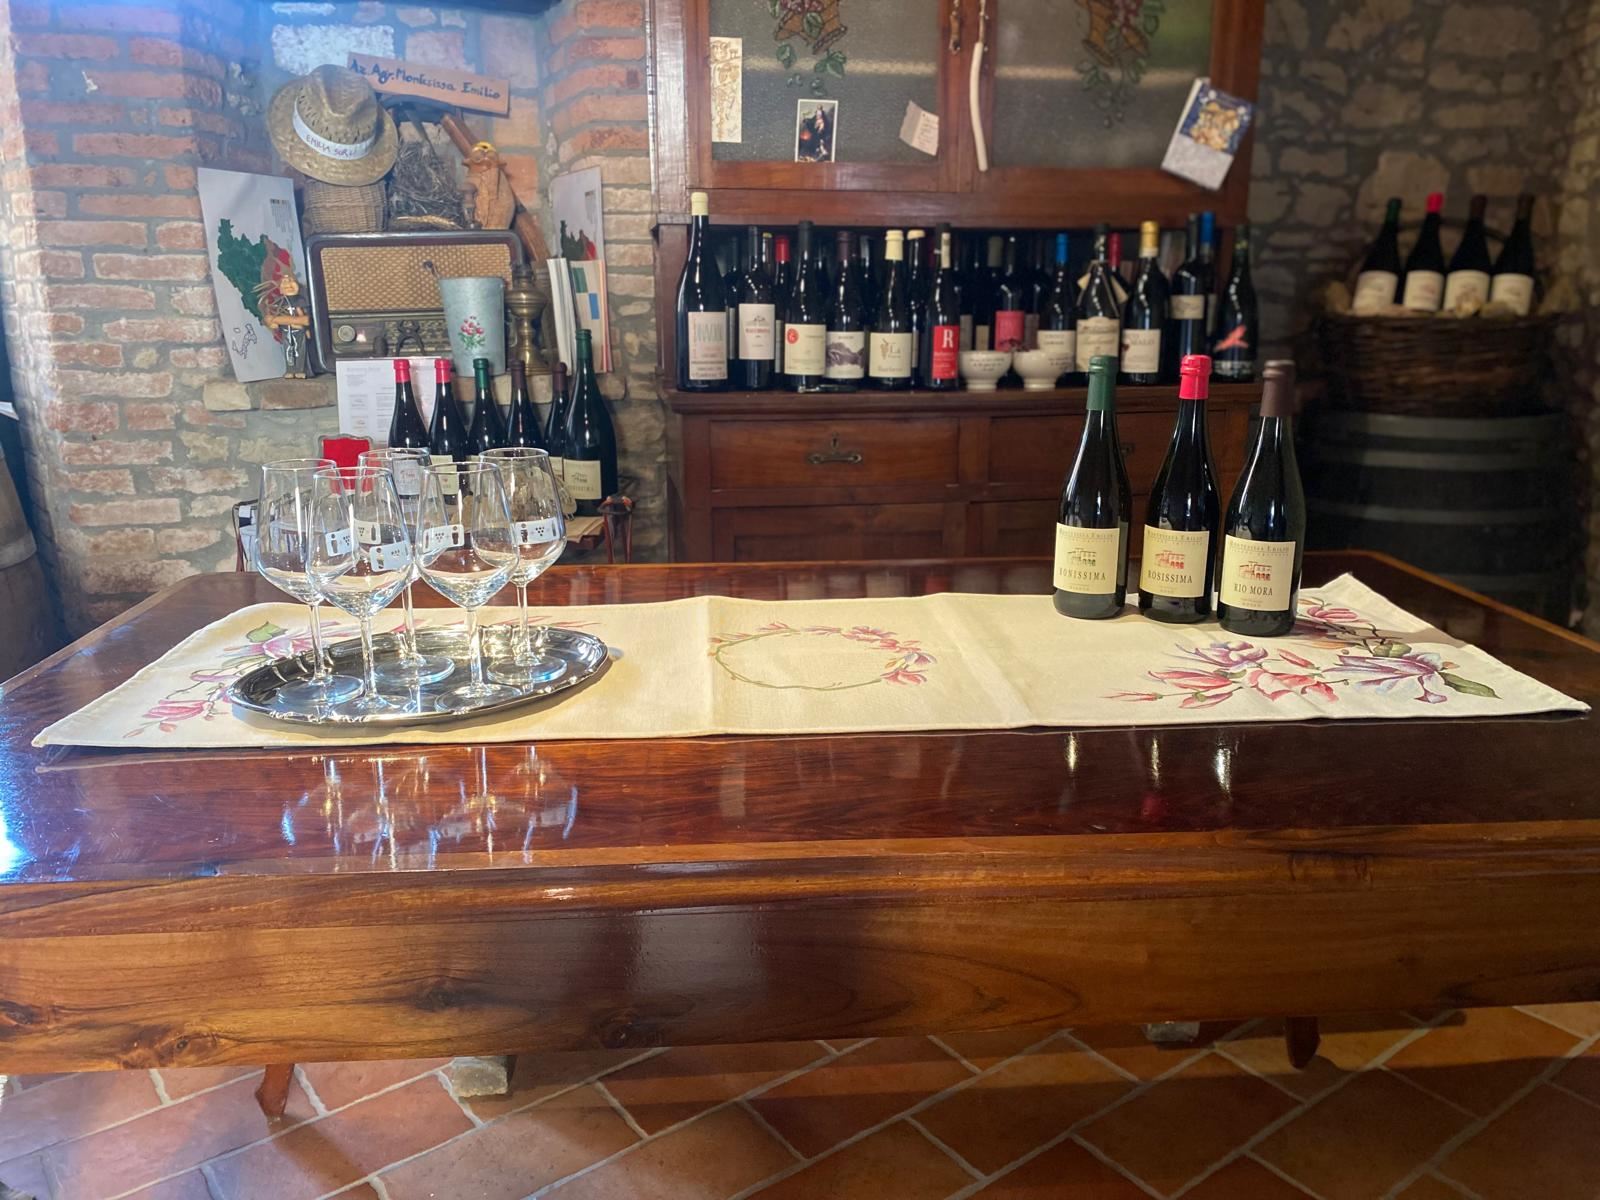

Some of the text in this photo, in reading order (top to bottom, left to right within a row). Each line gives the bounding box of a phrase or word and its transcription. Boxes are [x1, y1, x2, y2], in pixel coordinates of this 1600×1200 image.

[461, 81, 501, 99] Emilio
[941, 328, 954, 349] R
[1234, 583, 1273, 596] RIO MORA
